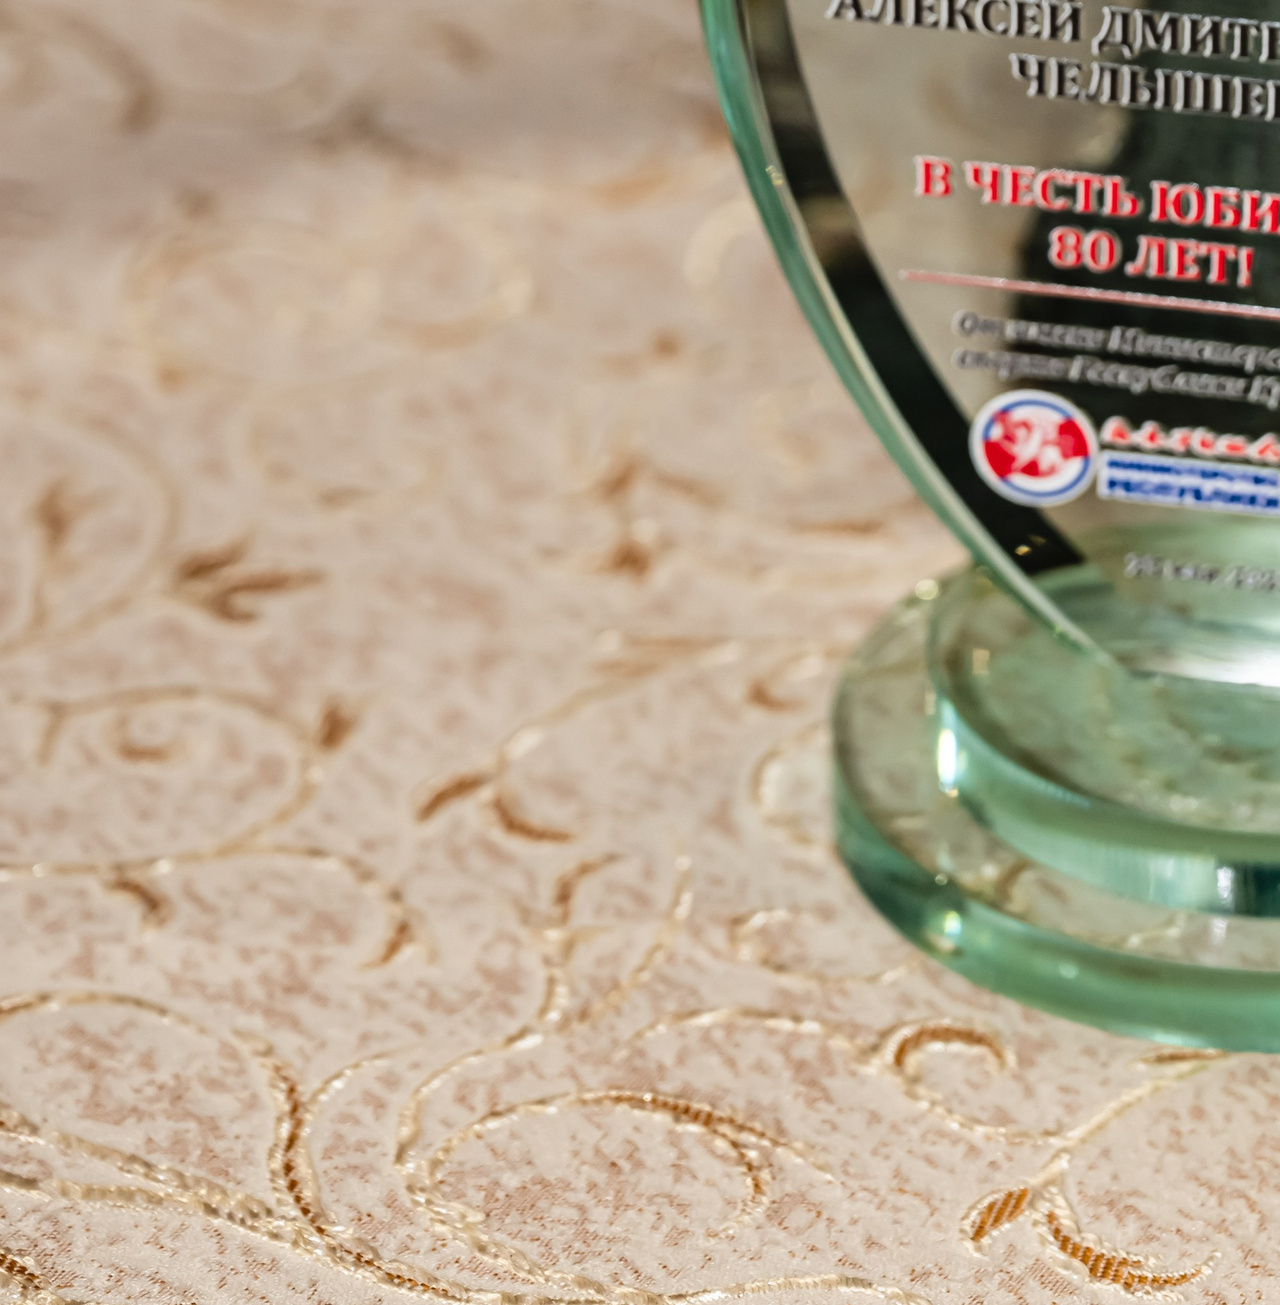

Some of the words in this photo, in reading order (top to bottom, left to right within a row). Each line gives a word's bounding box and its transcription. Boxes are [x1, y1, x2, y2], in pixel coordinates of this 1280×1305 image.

[914, 155, 953, 197] В
[962, 160, 1143, 218] ЧЕСТЬ
[1047, 225, 1123, 272] 80
[1125, 234, 1256, 288] ЛЕТ!
